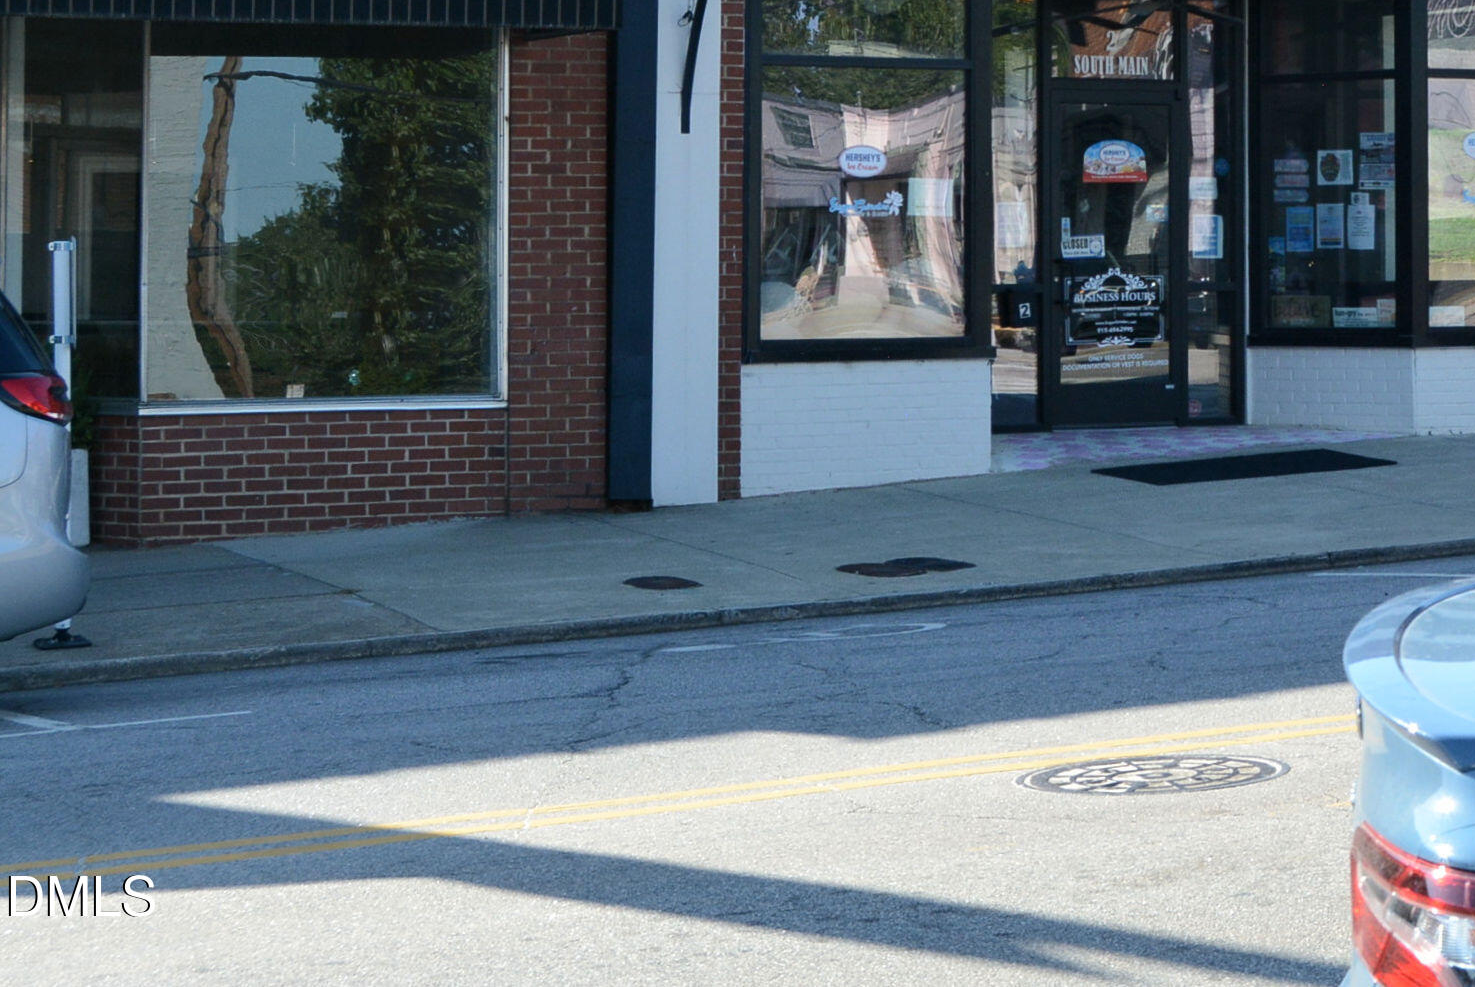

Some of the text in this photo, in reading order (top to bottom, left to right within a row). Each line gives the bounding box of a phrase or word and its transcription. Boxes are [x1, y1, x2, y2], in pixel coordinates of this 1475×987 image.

[1074, 54, 1149, 76] SOUTH MAIN
[845, 152, 881, 163] HERSHEY'S
[1062, 238, 1089, 250] CLOSED
[1074, 291, 1156, 304] BUSINESS HOURS
[1020, 304, 1029, 318] 2
